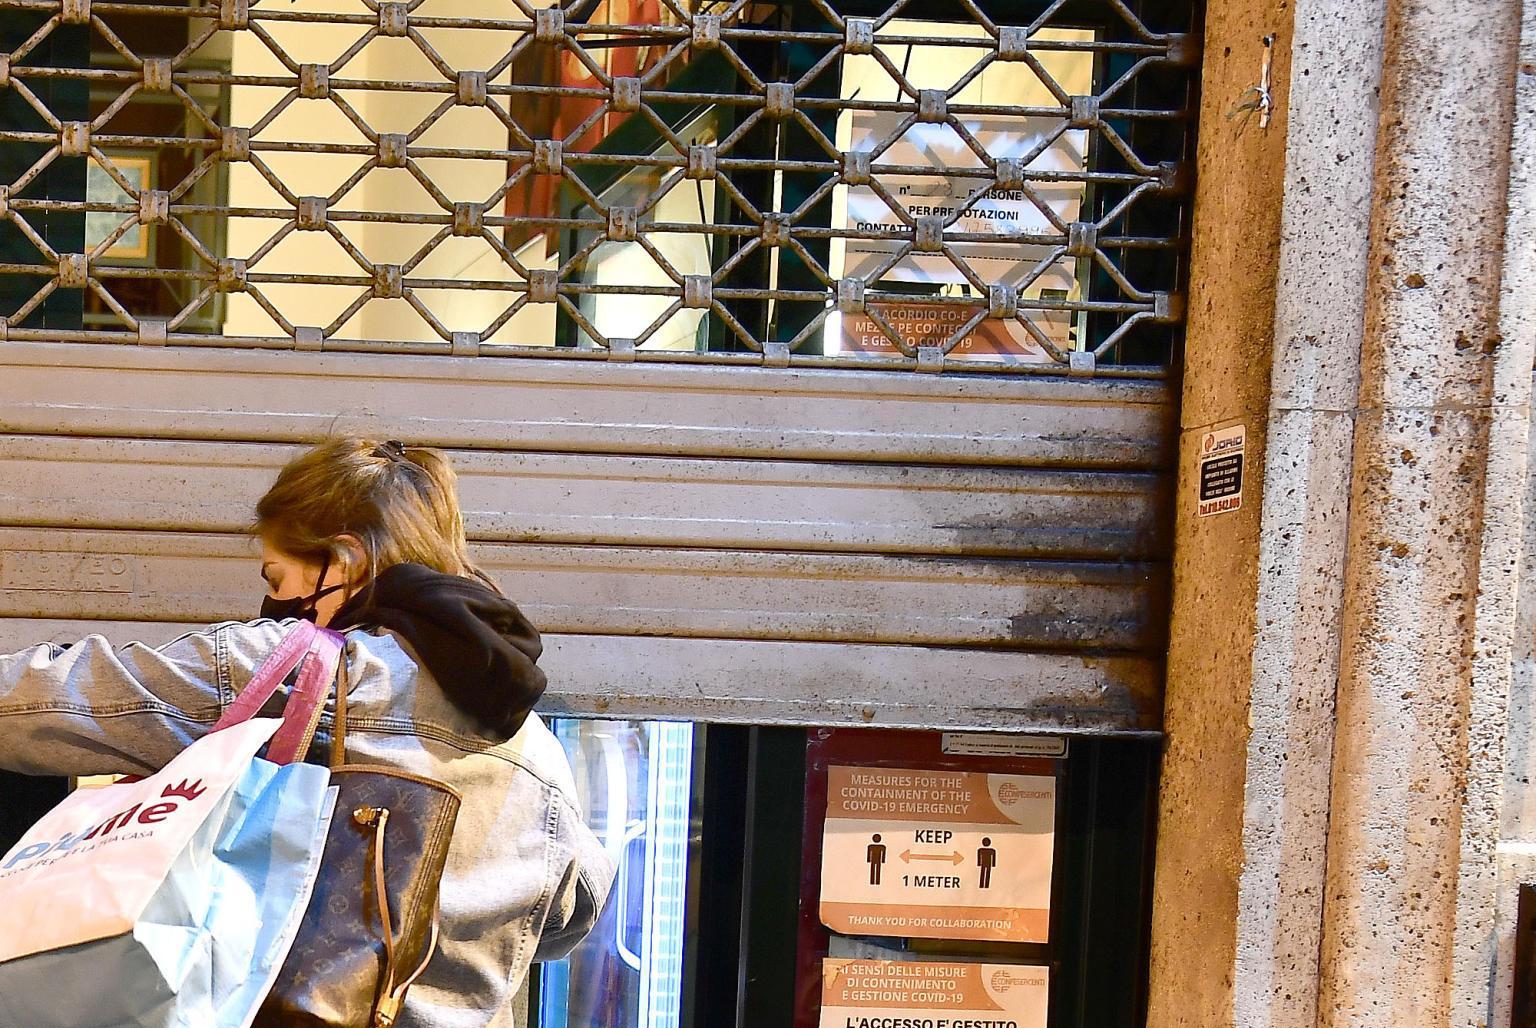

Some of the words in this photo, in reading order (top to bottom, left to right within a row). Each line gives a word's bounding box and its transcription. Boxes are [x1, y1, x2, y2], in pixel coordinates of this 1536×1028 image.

[909, 206, 931, 216] PER
[932, 207, 1019, 220] PREOTAZIONI
[862, 336, 868, 346] E
[851, 775, 911, 786] MEASURES
[915, 777, 937, 788] FOR
[940, 778, 962, 789] THE
[841, 788, 928, 800] CONTAINMENT
[931, 790, 946, 801] OF
[949, 791, 971, 801] THE
[843, 801, 896, 812] COVID-19
[899, 803, 969, 814] EMERGENCY
[915, 830, 952, 843] KEEP
[903, 875, 909, 886] 1
[914, 876, 960, 888] METER
[848, 916, 883, 925] THANK
[885, 917, 905, 926] YOU
[909, 918, 927, 927] FOR
[930, 919, 1012, 929] COLLABORATION
[852, 966, 884, 975] SENSI
[888, 967, 921, 976] DELLE
[930, 968, 966, 977] MISURE
[847, 979, 859, 988] DI
[863, 979, 956, 990] CONTENIMENTO
[843, 991, 848, 1000] E
[852, 991, 908, 1002] GESTIONE
[911, 993, 963, 1003] COVID-19
